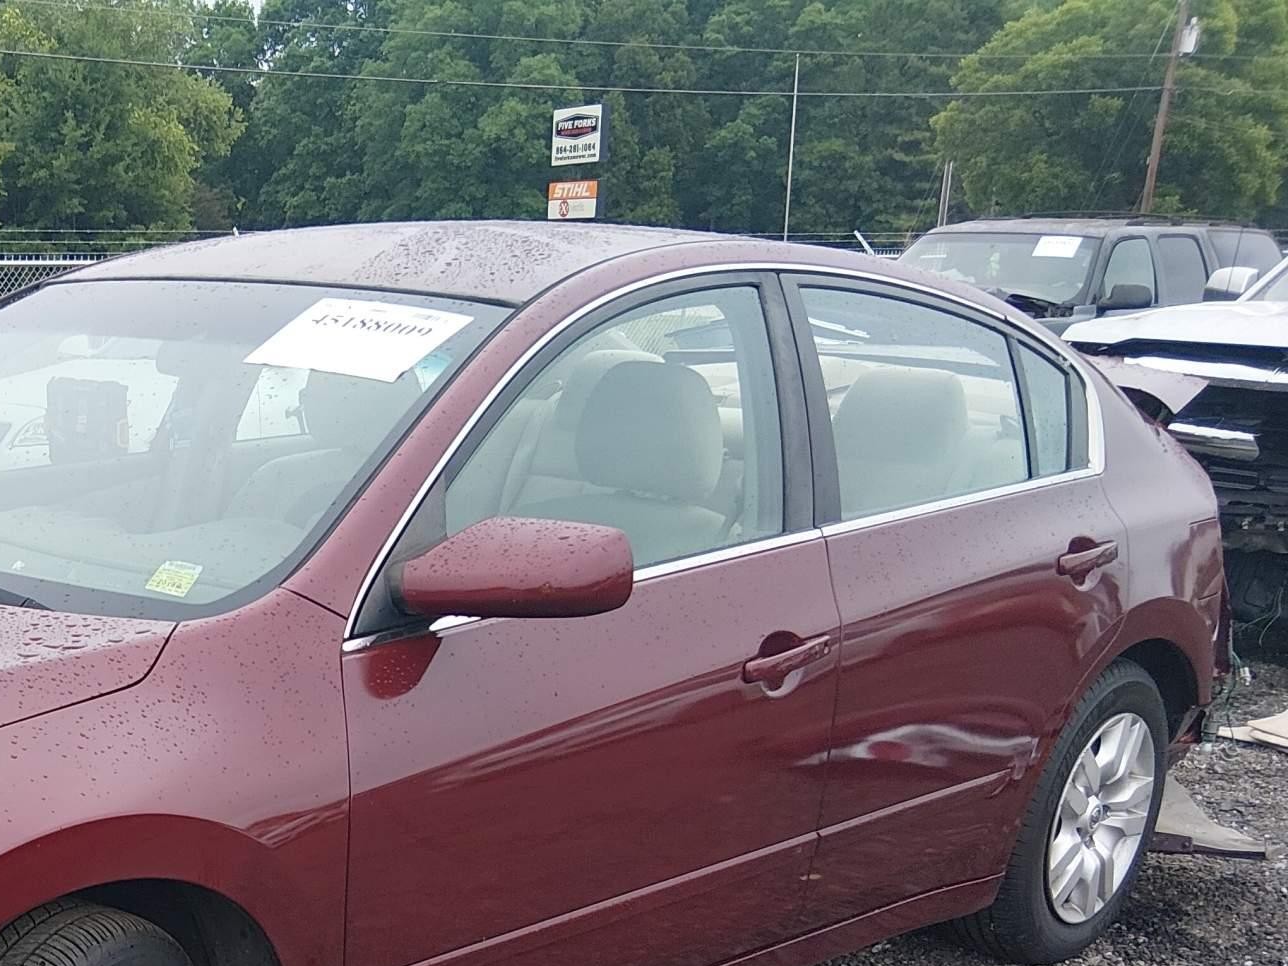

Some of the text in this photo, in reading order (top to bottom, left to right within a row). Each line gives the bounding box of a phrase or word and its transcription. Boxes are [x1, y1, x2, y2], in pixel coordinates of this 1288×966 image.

[558, 118, 596, 130] FIVE FORKS
[553, 184, 590, 198] STIHL
